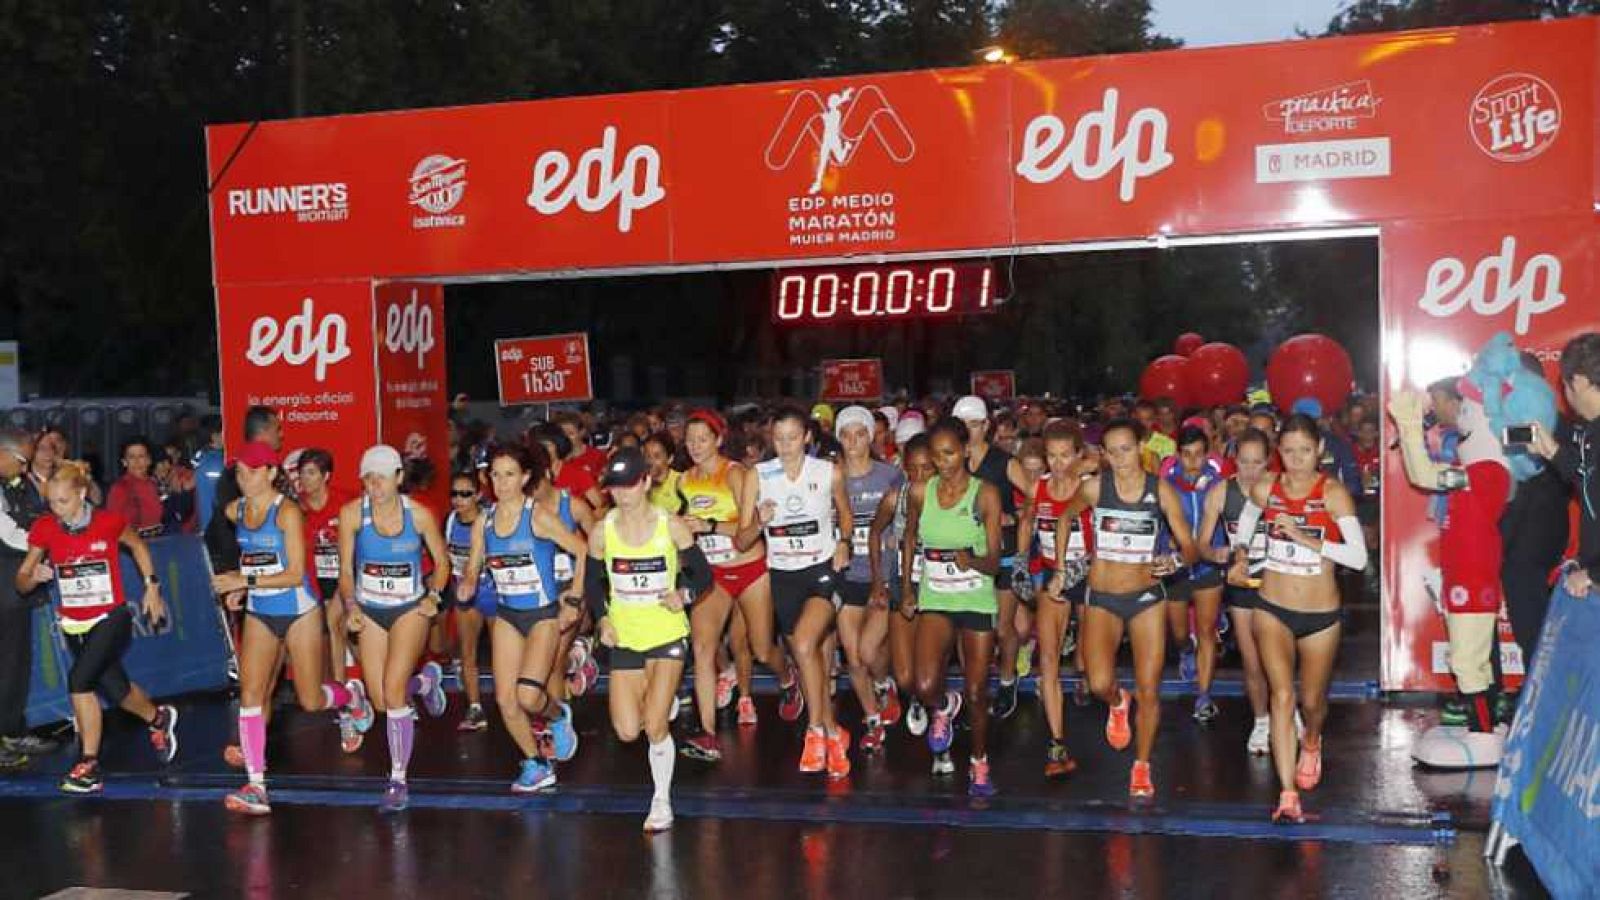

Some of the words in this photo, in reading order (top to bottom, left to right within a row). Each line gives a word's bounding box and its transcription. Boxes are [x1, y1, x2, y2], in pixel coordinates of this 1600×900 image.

[1475, 83, 1541, 124] Sport
[1488, 105, 1559, 151] Life
[1017, 87, 1174, 202] edp
[1294, 149, 1376, 169] MADRID
[527, 125, 666, 233] edp
[228, 182, 348, 215] RUNNER'S
[788, 197, 824, 212] EDP
[832, 192, 894, 210] MEDIO
[789, 207, 895, 231] MARATÓN
[838, 228, 896, 243] MADRID
[1418, 236, 1566, 335] edp
[246, 297, 351, 382] edp
[386, 288, 434, 370] edp
[529, 356, 555, 372] SUB
[789, 538, 804, 549] 13
[76, 579, 92, 590] 53
[379, 579, 394, 590] 16
[632, 575, 649, 588] 12
